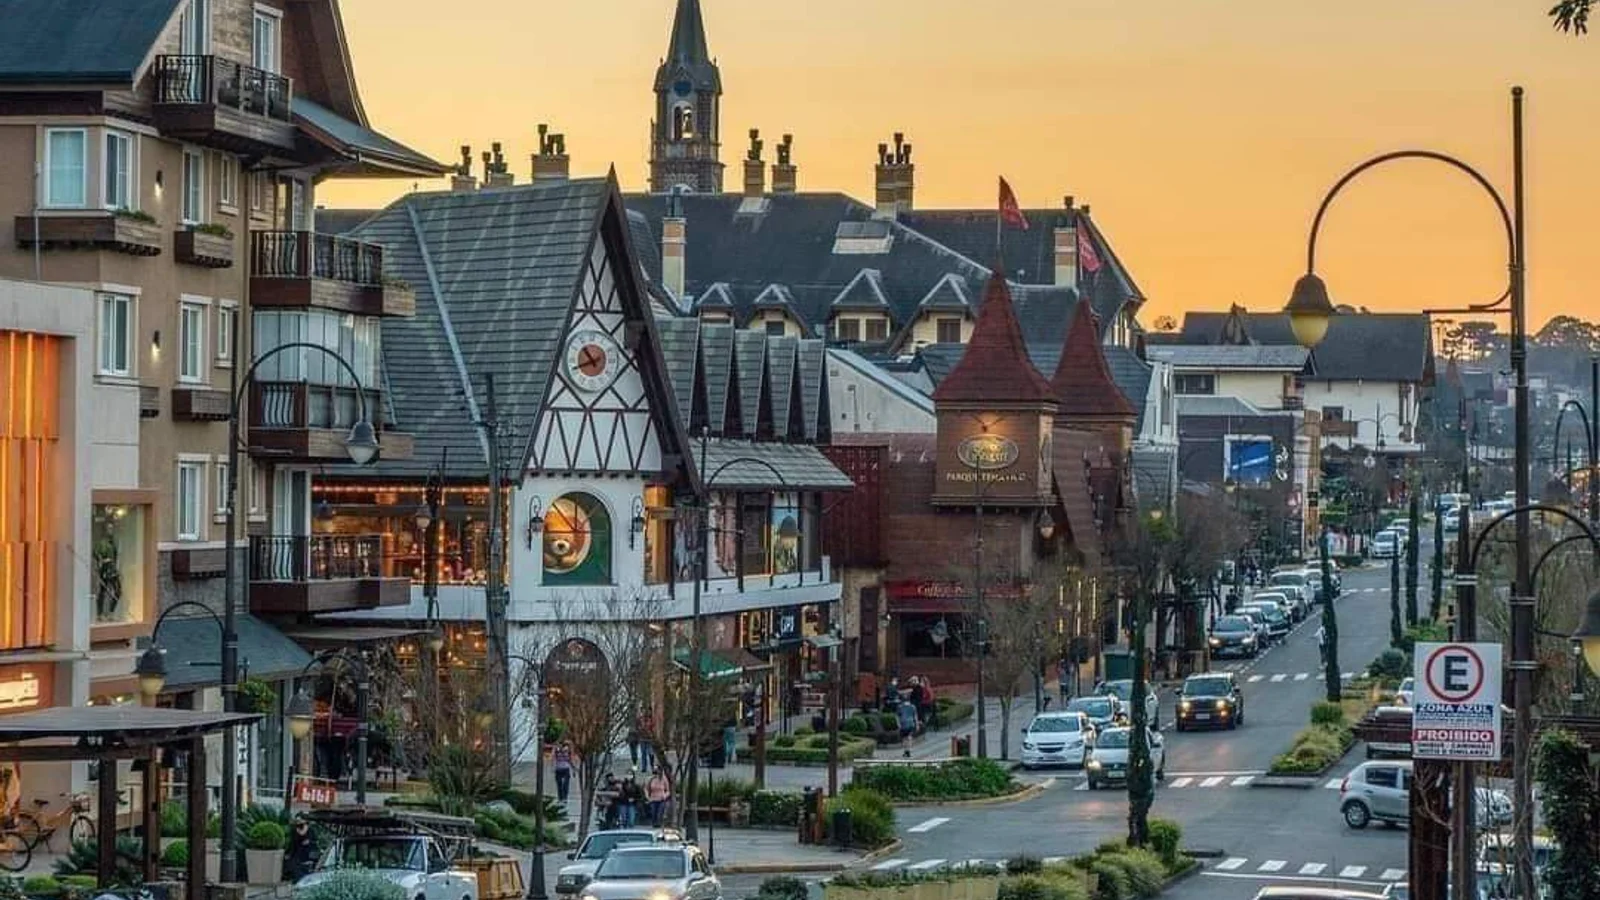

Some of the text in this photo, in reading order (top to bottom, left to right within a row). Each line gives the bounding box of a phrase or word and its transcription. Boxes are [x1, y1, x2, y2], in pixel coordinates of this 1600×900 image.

[1444, 656, 1469, 691] E
[1420, 703, 1490, 713] ZONA AZUL
[1417, 730, 1491, 742] PROIBIDO
